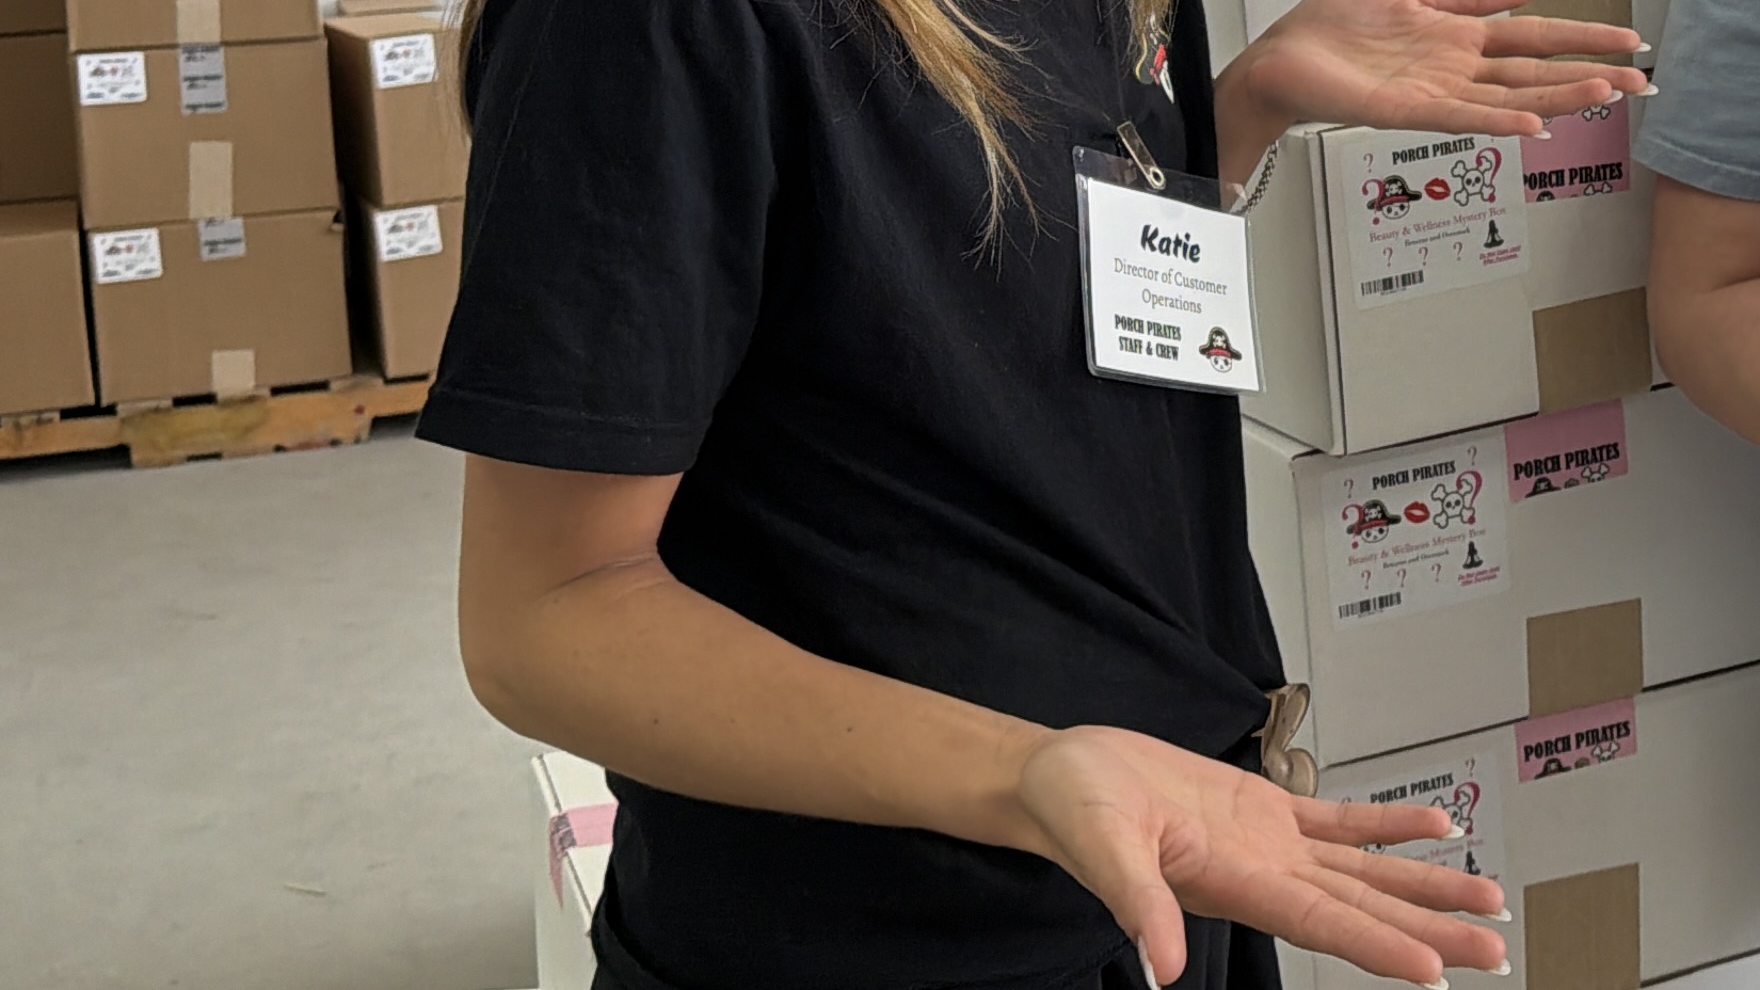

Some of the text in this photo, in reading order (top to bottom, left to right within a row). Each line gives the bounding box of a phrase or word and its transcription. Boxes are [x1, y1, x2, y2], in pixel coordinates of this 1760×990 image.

[1391, 137, 1476, 167] PORCH PIRATES
[1568, 162, 1623, 187] PIRATES
[1140, 224, 1201, 263] Katie
[1114, 258, 1228, 296] Director of Customer
[1142, 289, 1202, 314] Operations
[1114, 314, 1182, 342] PORCH PIRATES
[1119, 336, 1179, 361] STAFF & CREW
[1372, 460, 1456, 491] PORCH PIRATES
[1513, 442, 1620, 481] PORCH PIRATES
[1523, 720, 1631, 762] PORCH PIRATES
[1370, 772, 1455, 805] PORCH PIRATES
